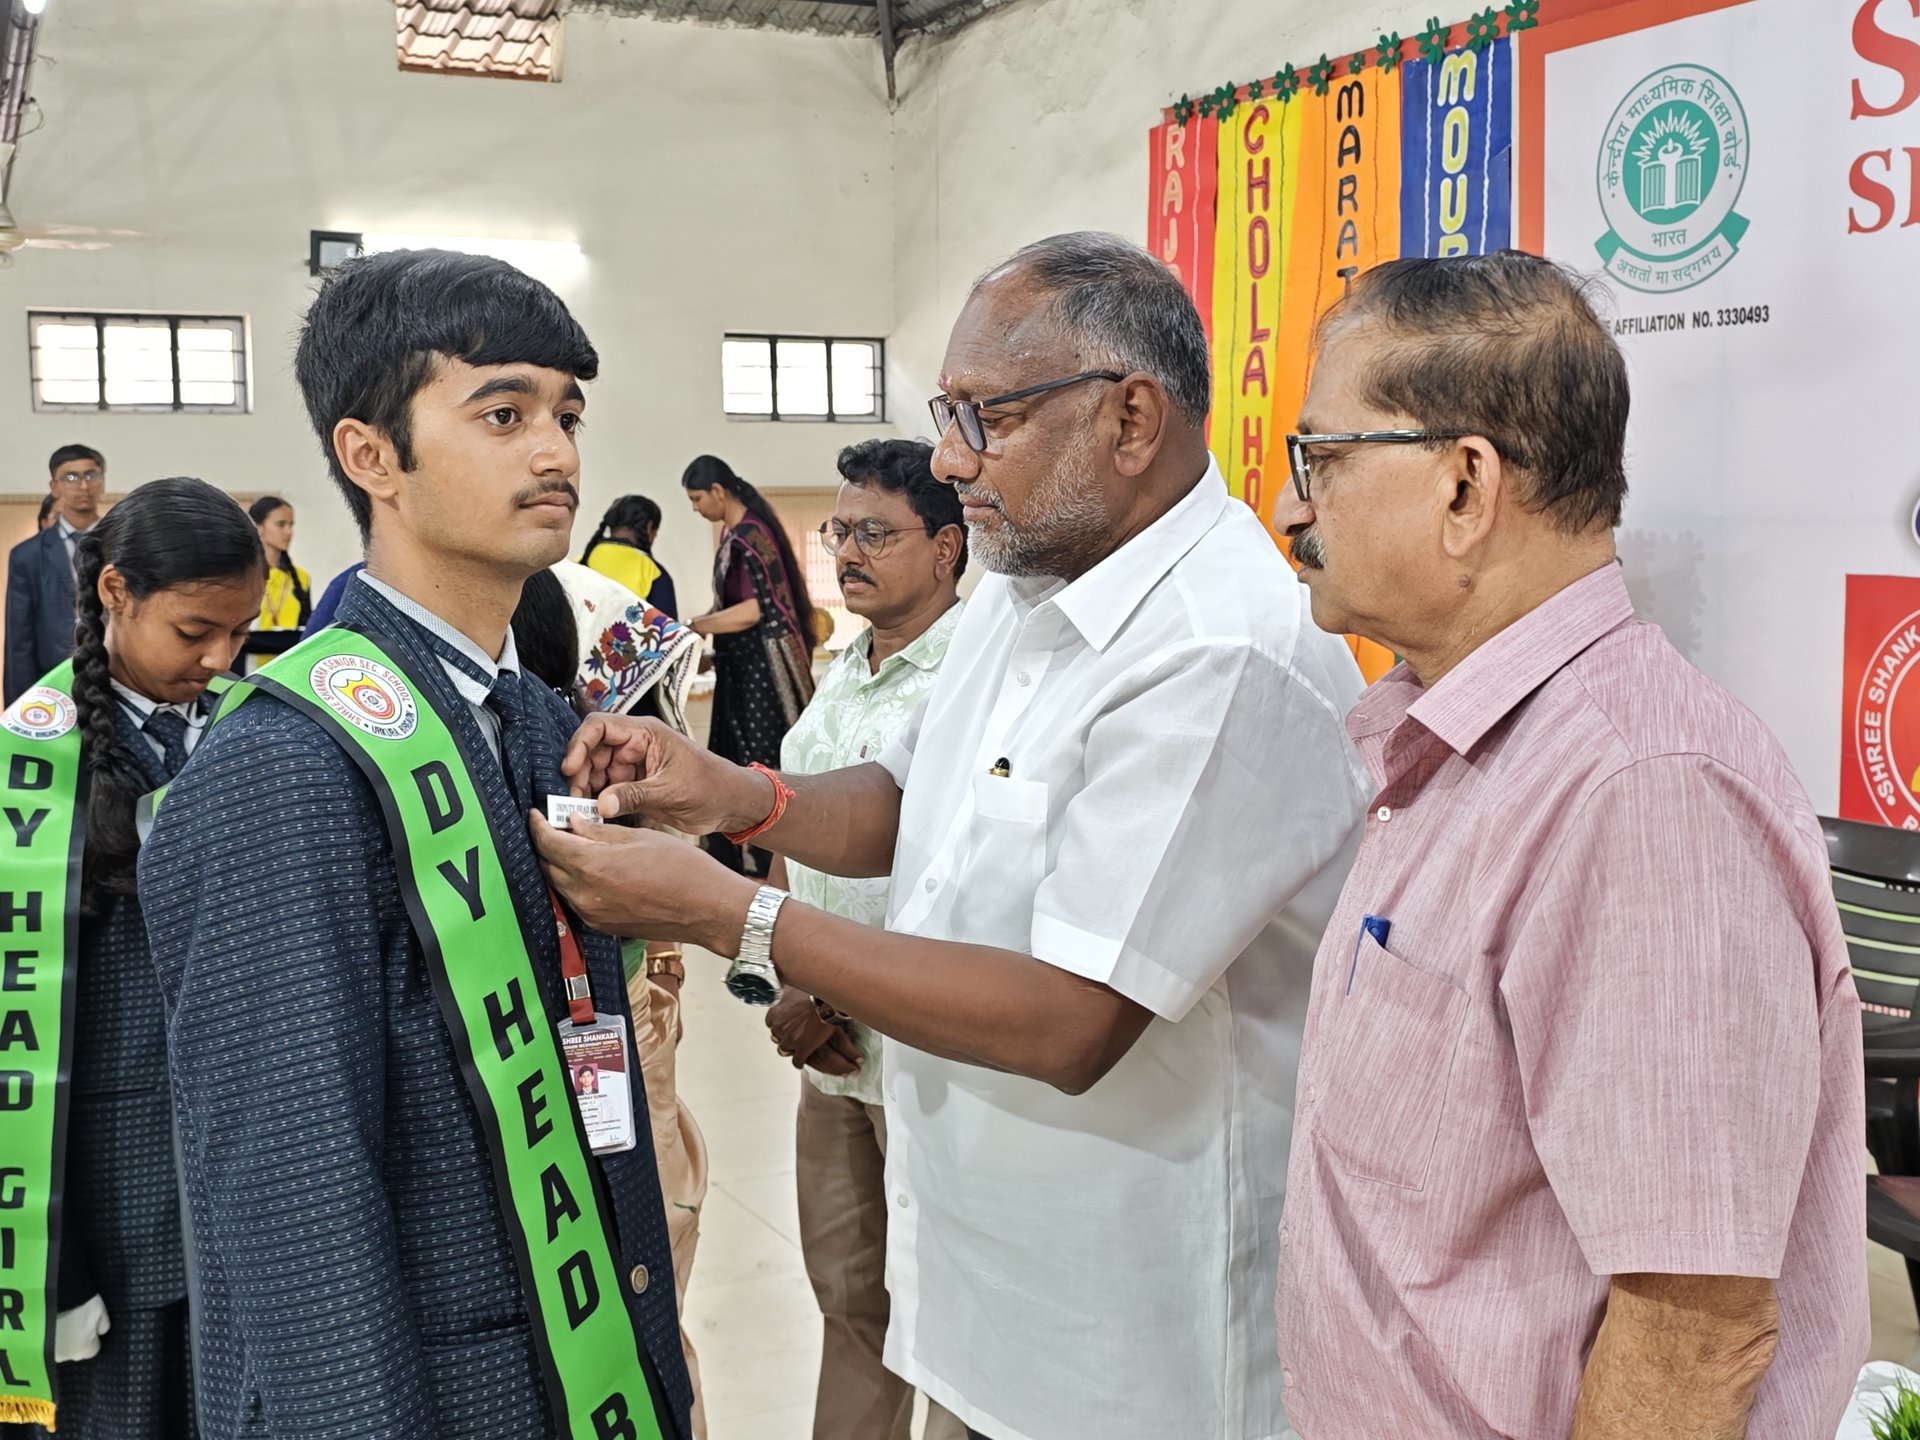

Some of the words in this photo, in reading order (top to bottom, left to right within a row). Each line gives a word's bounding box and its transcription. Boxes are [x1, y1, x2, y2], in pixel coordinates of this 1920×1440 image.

[1626, 75, 1696, 118] माध्यमिक
[1698, 79, 1732, 126] शिक्षा
[1242, 104, 1270, 397] CHOLA
[1652, 229, 1688, 248] भारत
[1617, 259, 1652, 283] असतो
[1655, 271, 1669, 284] मा
[1614, 313, 1685, 336] AFFILIATION
[1692, 311, 1713, 328] NO.
[1717, 305, 1769, 326] 3330493
[323, 657, 356, 670] SENIOR
[382, 670, 411, 701] SCHOOL
[331, 701, 361, 726] SHREE
[1864, 710, 1894, 798] SHREE
[2, 754, 54, 847] DY
[0, 891, 43, 1111] HEAD
[410, 760, 484, 922] DY
[482, 976, 600, 1331] HEAD
[562, 1036, 582, 1045] SHREE
[583, 1032, 619, 1043] SHANKARA
